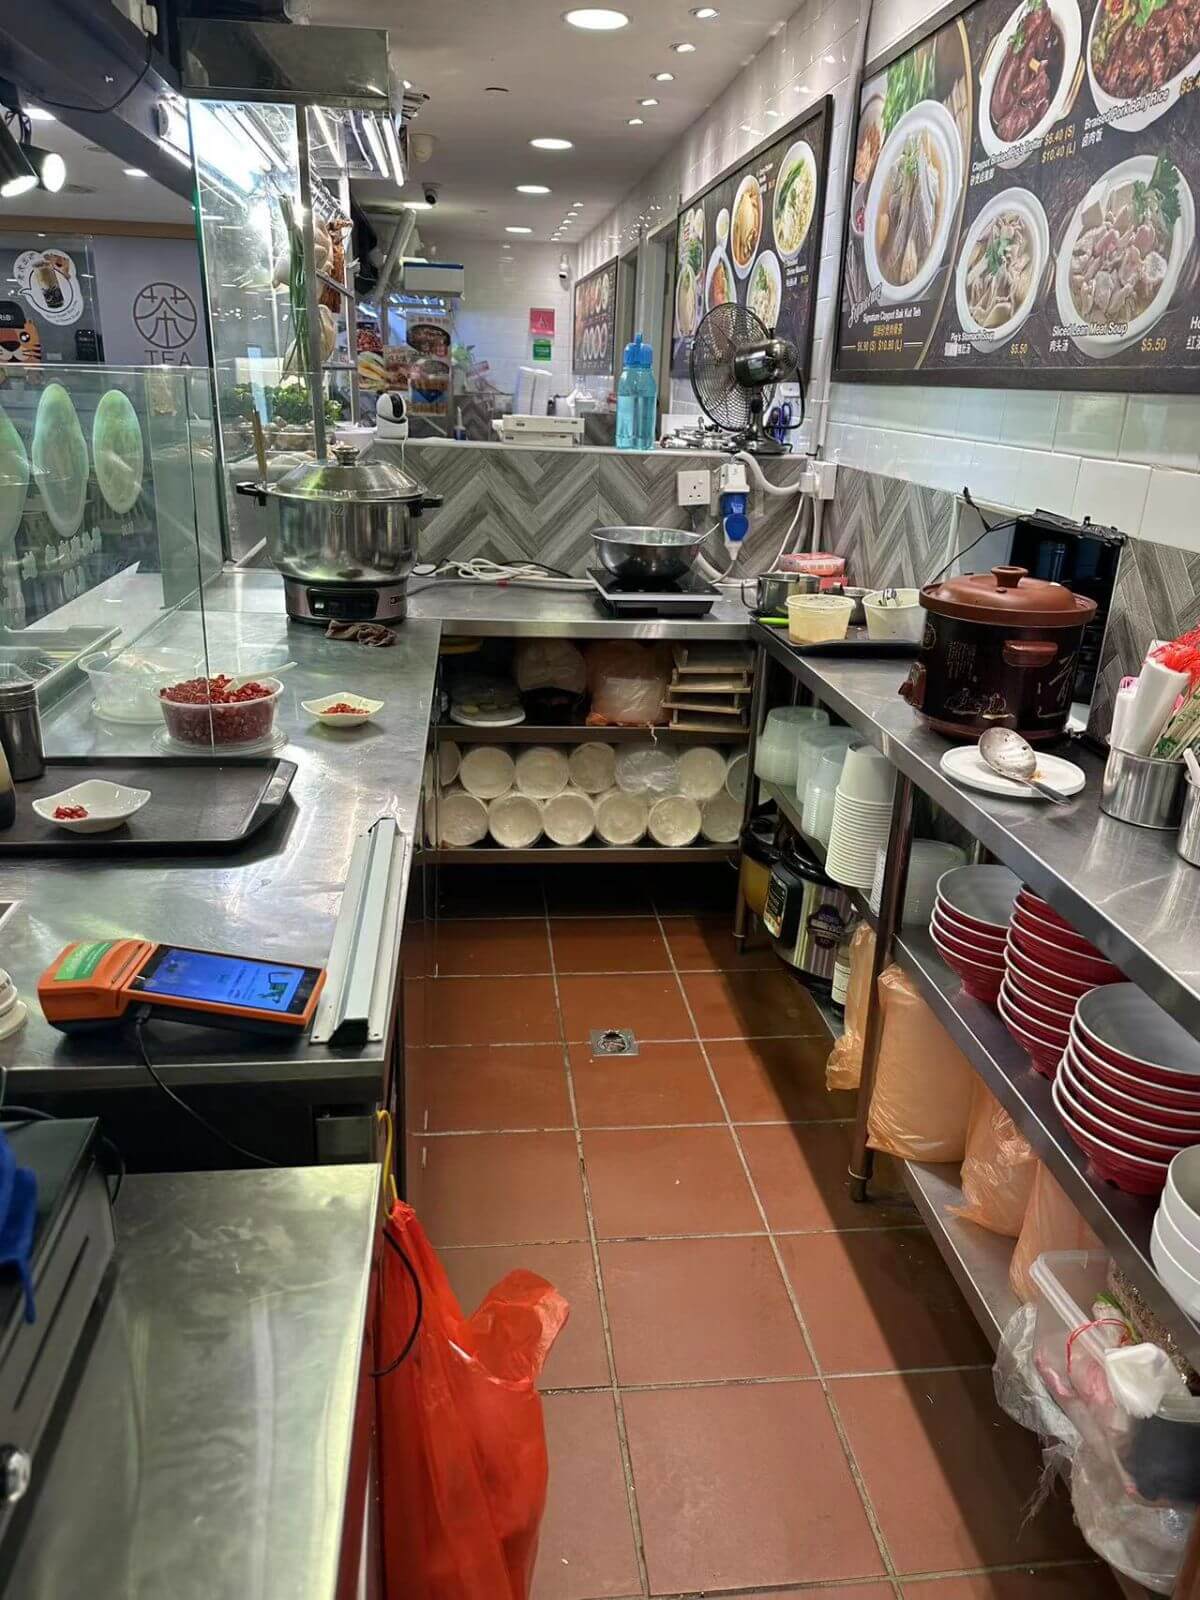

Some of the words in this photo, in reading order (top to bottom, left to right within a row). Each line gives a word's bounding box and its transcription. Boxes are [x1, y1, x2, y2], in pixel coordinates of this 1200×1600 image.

[1089, 322, 1106, 336] Meat
[1108, 321, 1128, 337] Soup
[1141, 338, 1166, 352] $5.50
